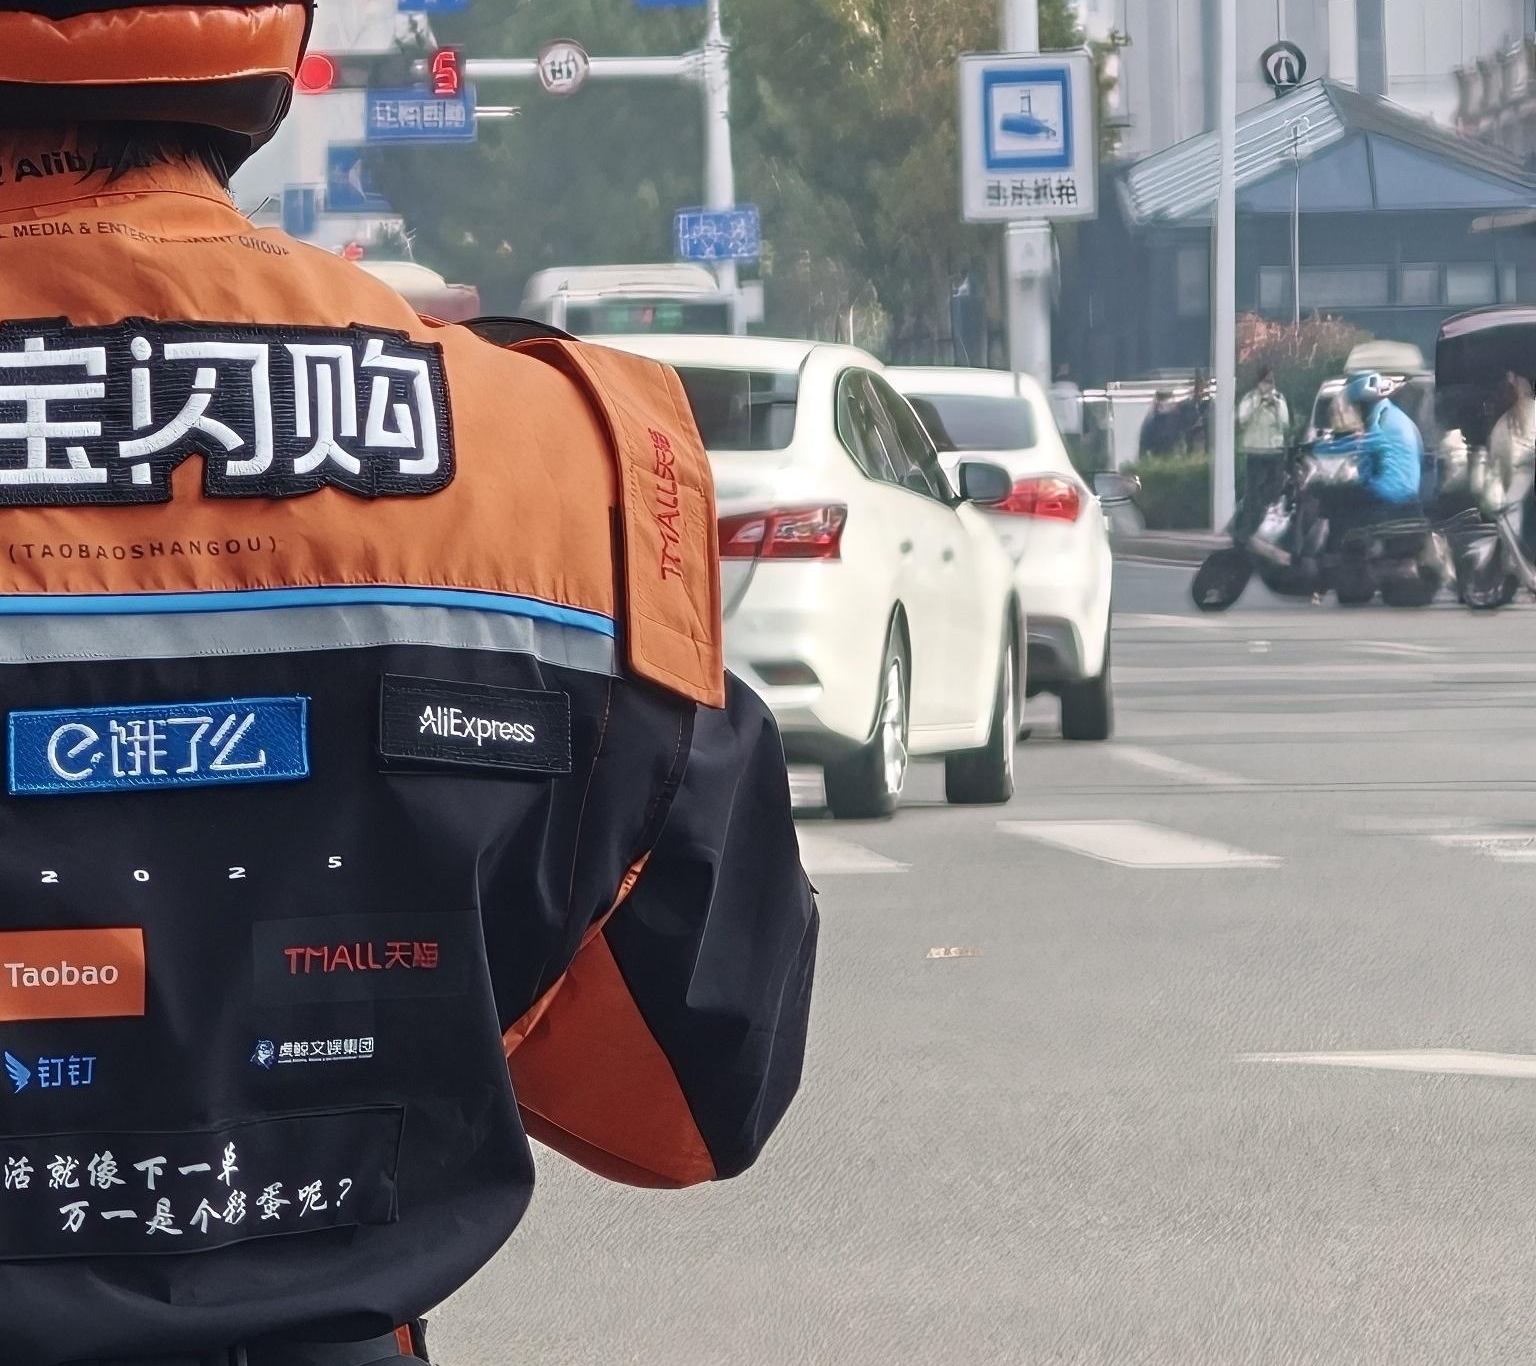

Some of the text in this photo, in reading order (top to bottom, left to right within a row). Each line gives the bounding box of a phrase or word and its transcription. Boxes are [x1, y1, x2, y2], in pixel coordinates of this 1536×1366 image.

[431, 50, 458, 95] 5
[13, 221, 72, 239] MEDIA
[78, 222, 91, 236] &
[8, 535, 277, 562] (TAOBAOSHANGOU)
[418, 704, 536, 747] AliExpress
[4, 960, 120, 988] Taobao
[278, 1037, 374, 1058] 虎鲸文娱集团
[37, 1054, 97, 1088] 钉钉
